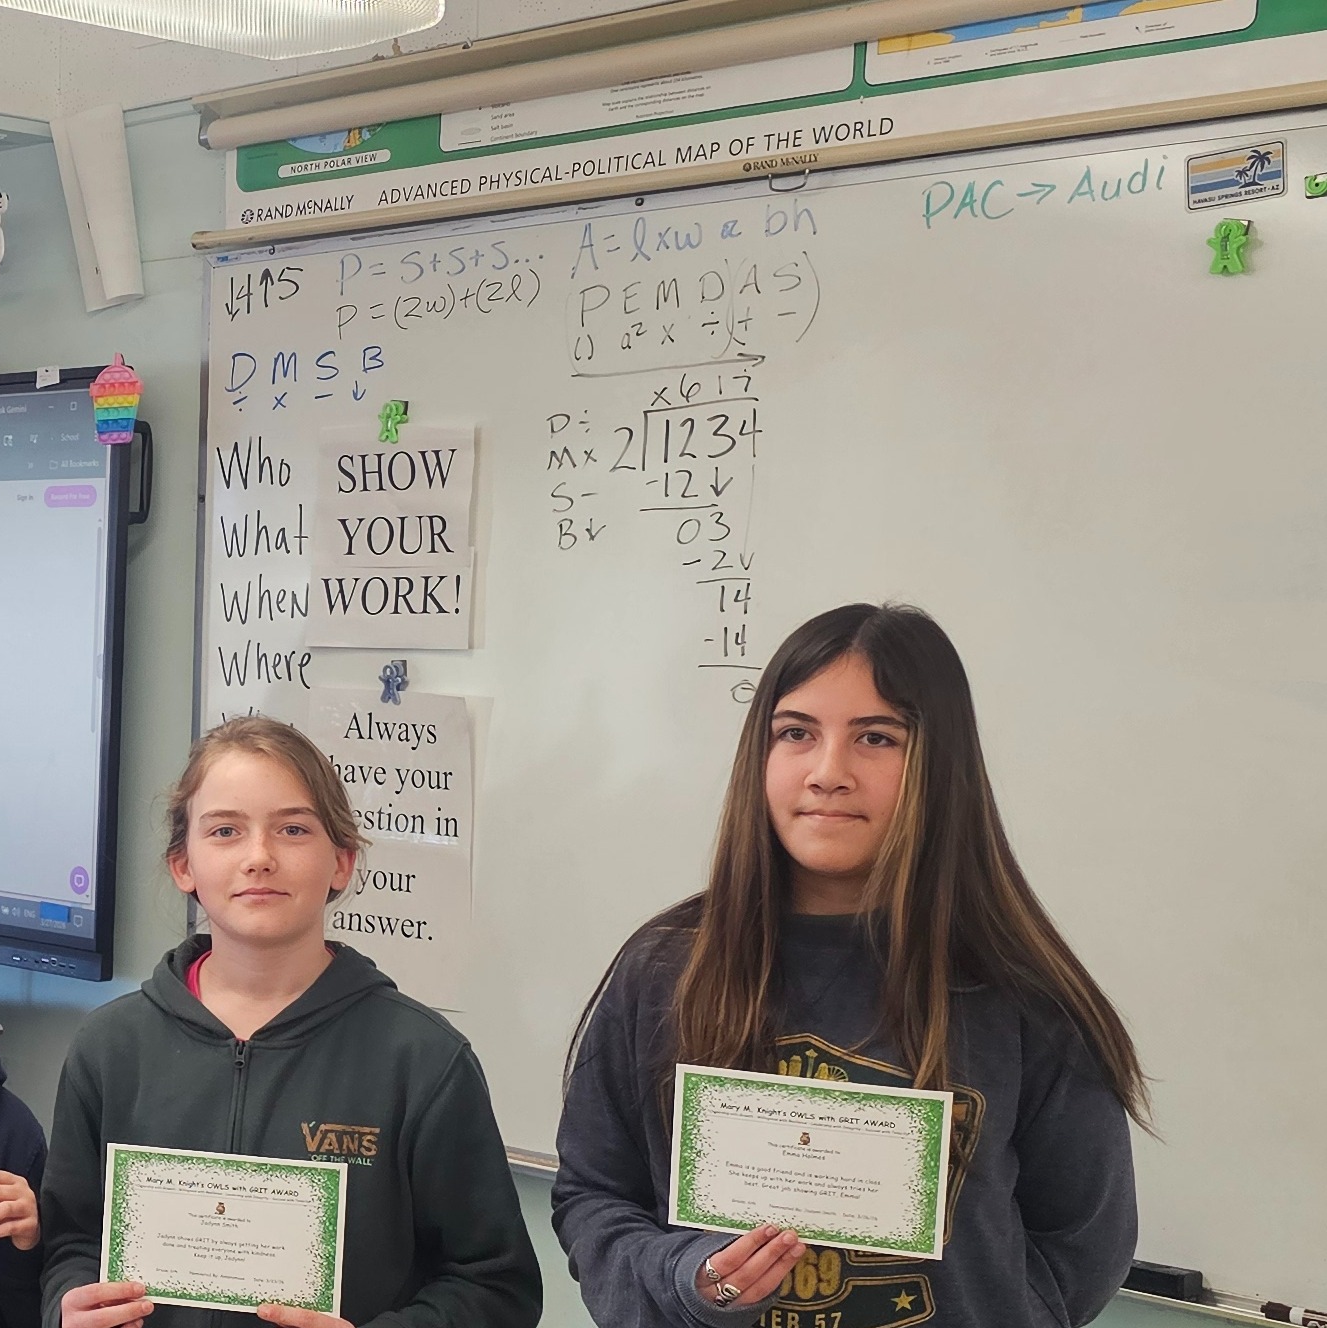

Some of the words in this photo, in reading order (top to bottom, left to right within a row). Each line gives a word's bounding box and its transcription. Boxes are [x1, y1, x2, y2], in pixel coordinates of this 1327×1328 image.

[290, 162, 321, 174] NORTH
[324, 158, 352, 170] POLAR
[355, 153, 378, 164] VIEW
[377, 174, 472, 205] ADVANCED
[477, 150, 666, 193] PHYSICAL-POLITICAL
[675, 142, 721, 165] MAP
[729, 135, 756, 156] OF
[763, 128, 803, 150] THE
[812, 117, 894, 142] WORLD
[753, 160, 777, 170] RAND
[921, 178, 1016, 230] PAC
[1067, 154, 1169, 204] Audi
[1193, 195, 1216, 205] HAVASU
[1218, 191, 1242, 200] SPRINGS
[1244, 187, 1266, 196] RESORT
[256, 204, 294, 222] RAND
[224, 352, 257, 393] D
[271, 351, 297, 385] M
[361, 346, 385, 374] B
[60, 433, 79, 442] School
[216, 436, 291, 490] Who
[337, 448, 458, 494] SHOW
[220, 503, 309, 558] What
[337, 514, 454, 556] YOUR
[321, 574, 462, 616] WORK!
[218, 639, 312, 690] Where
[344, 712, 437, 751] Always
[394, 768, 453, 795] your
[435, 807, 459, 838] in
[356, 867, 416, 895] your
[333, 909, 433, 942] answer.
[720, 1102, 740, 1112] Mary
[790, 1110, 815, 1121] OWLS
[819, 1114, 836, 1123] with
[839, 1116, 860, 1125] GRIT
[863, 1119, 896, 1129] AWARD
[301, 1121, 380, 1156] VANS
[146, 1177, 163, 1186] Mary
[207, 1182, 230, 1191] OWLS
[232, 1185, 246, 1193] with
[249, 1186, 268, 1194] GRIT
[271, 1189, 299, 1197] AWARD
